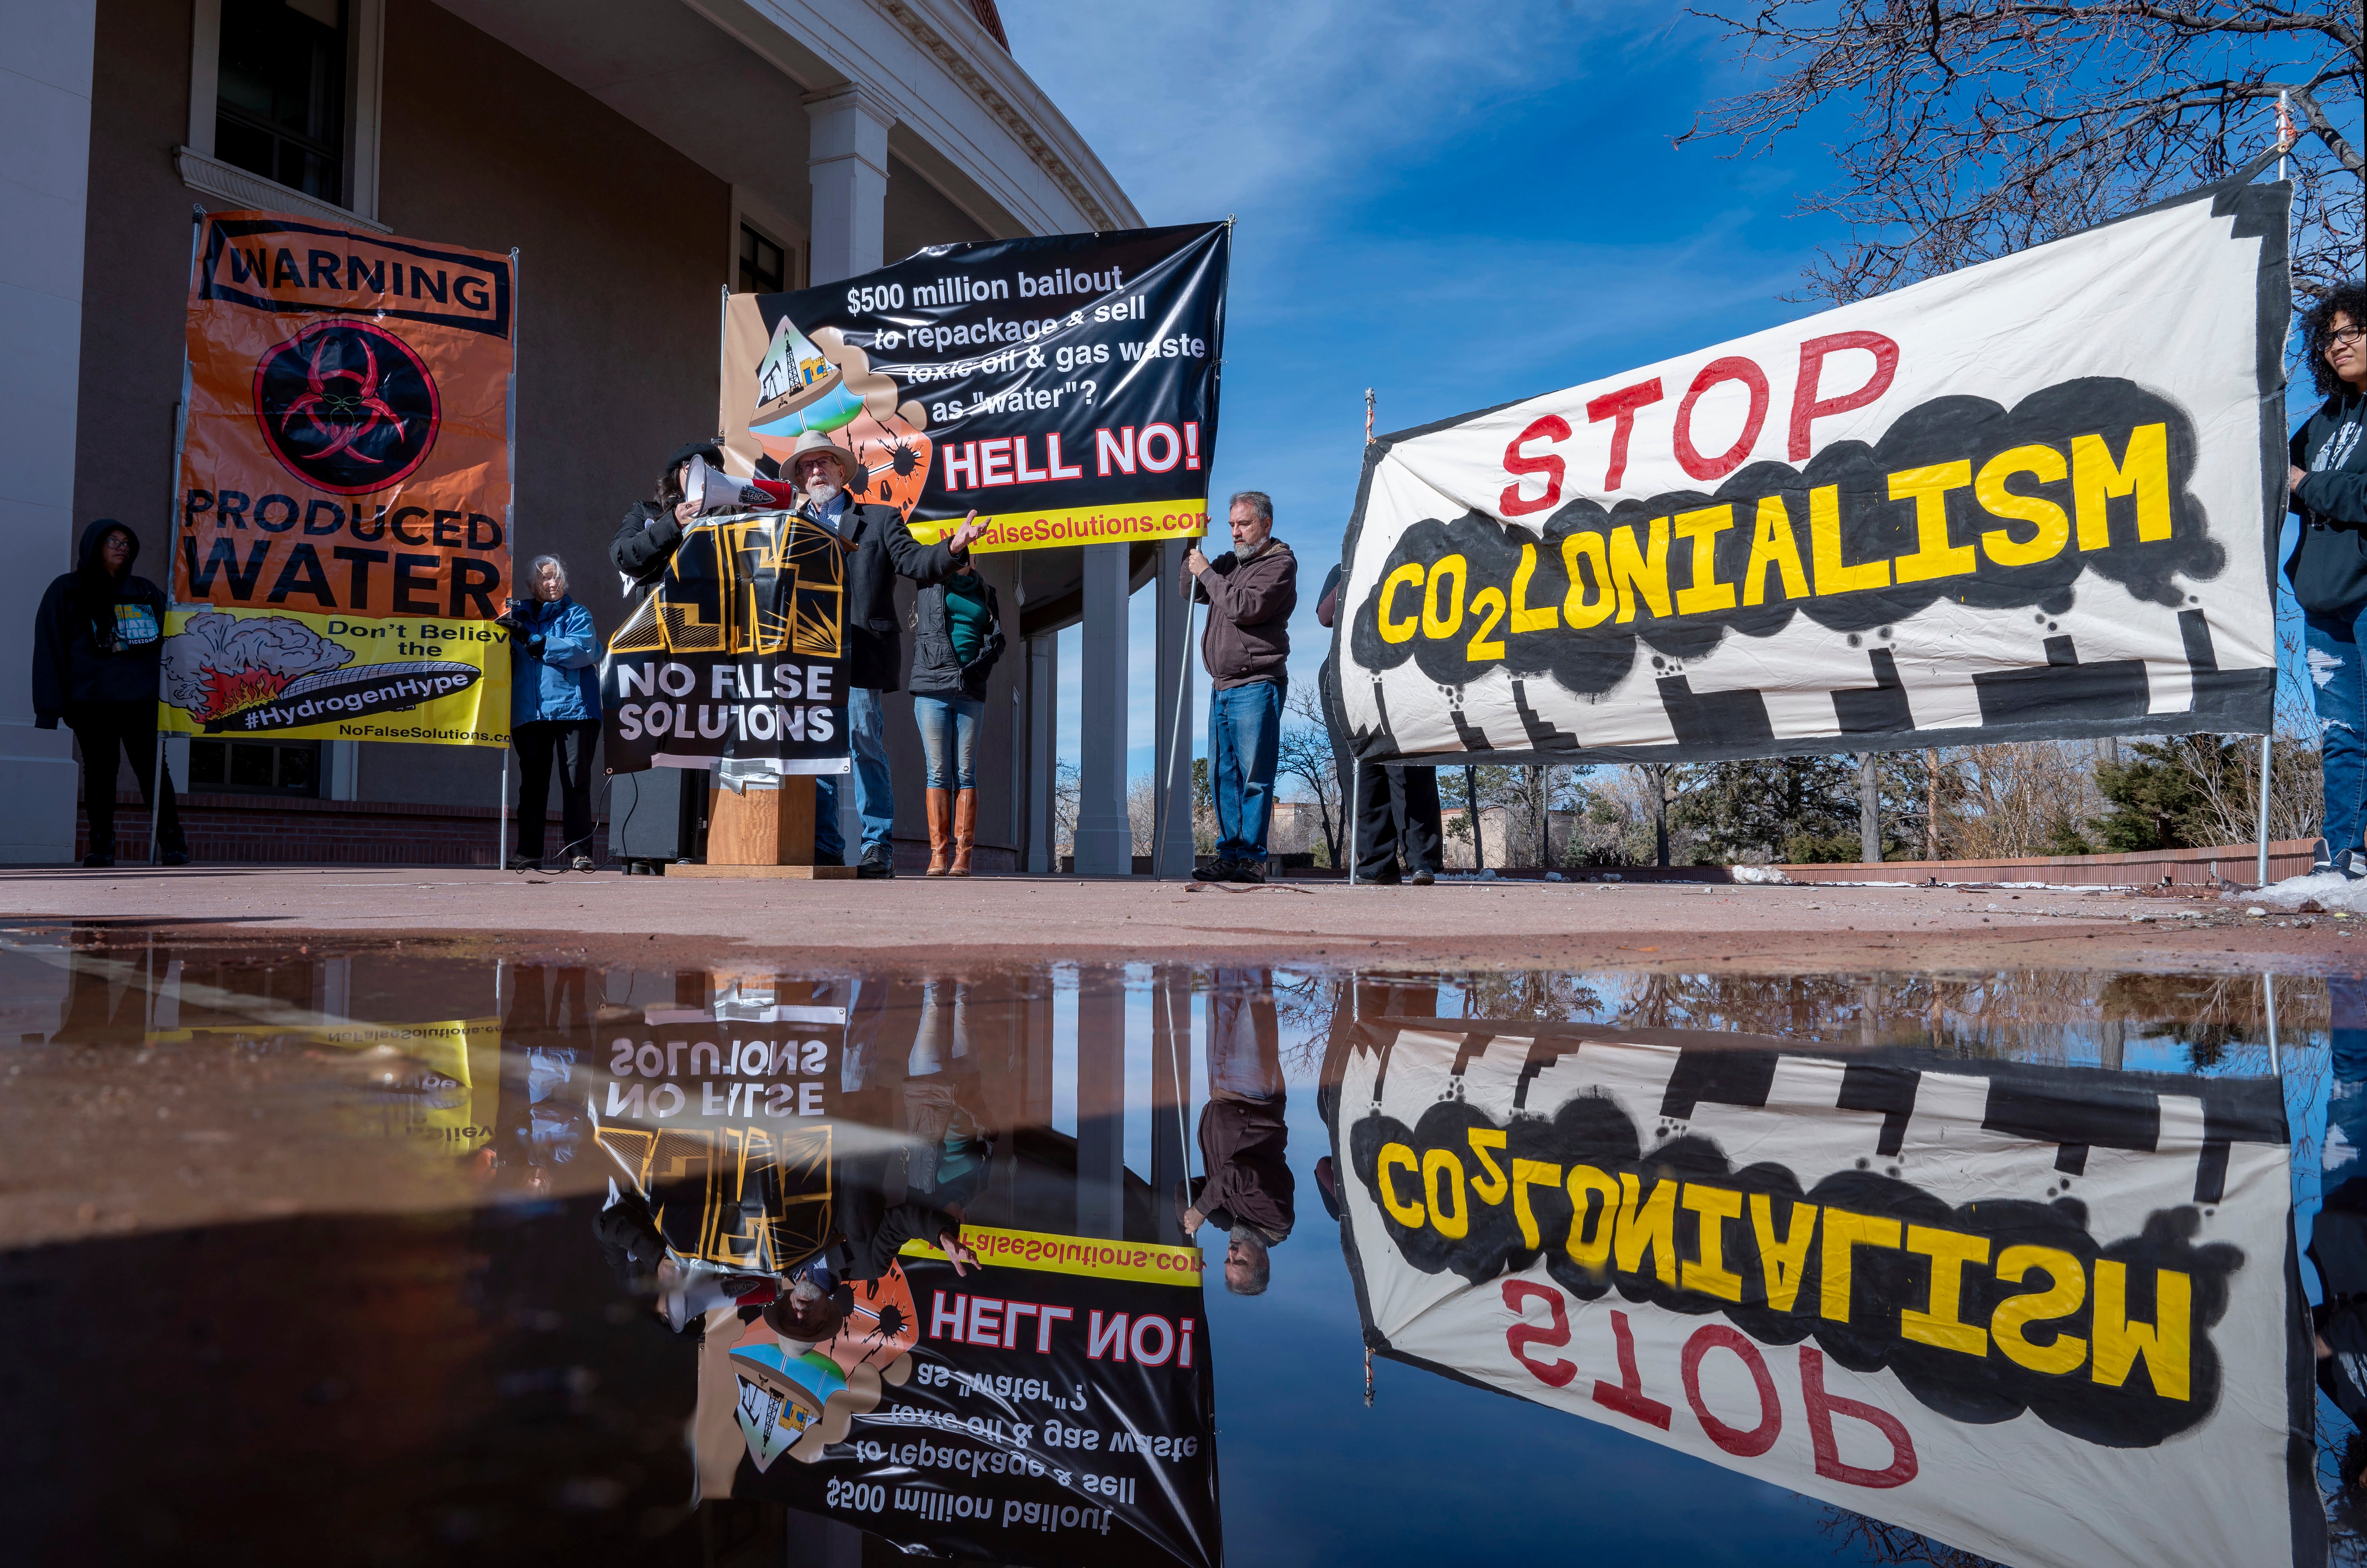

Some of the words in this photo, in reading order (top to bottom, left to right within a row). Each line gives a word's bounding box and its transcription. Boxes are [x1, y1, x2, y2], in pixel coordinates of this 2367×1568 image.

[230, 247, 490, 311] WARNING
[847, 283, 904, 317] $500
[913, 276, 1009, 307] million
[1019, 265, 1124, 298] bailout
[874, 328, 899, 350] to
[908, 317, 1058, 353] repackage
[1066, 311, 1085, 327] &
[1095, 295, 1145, 322] sell
[907, 356, 974, 384] toxic
[981, 349, 1015, 375] oil
[1025, 344, 1046, 369] &
[1056, 342, 1110, 373] gas
[1119, 333, 1205, 362] waste
[932, 400, 963, 423] as
[1499, 330, 1900, 516] STOP
[942, 432, 1082, 491] HELL
[1096, 421, 1200, 477] NO!
[185, 489, 503, 551] PRODUCED
[183, 536, 501, 619] WATER
[118, 619, 155, 629] MATE
[126, 628, 156, 638] TICE
[327, 621, 406, 638] Don't
[398, 642, 442, 657] the
[245, 673, 469, 729] #HydrogenHype
[617, 662, 696, 698] NO
[712, 664, 833, 700] FALSE
